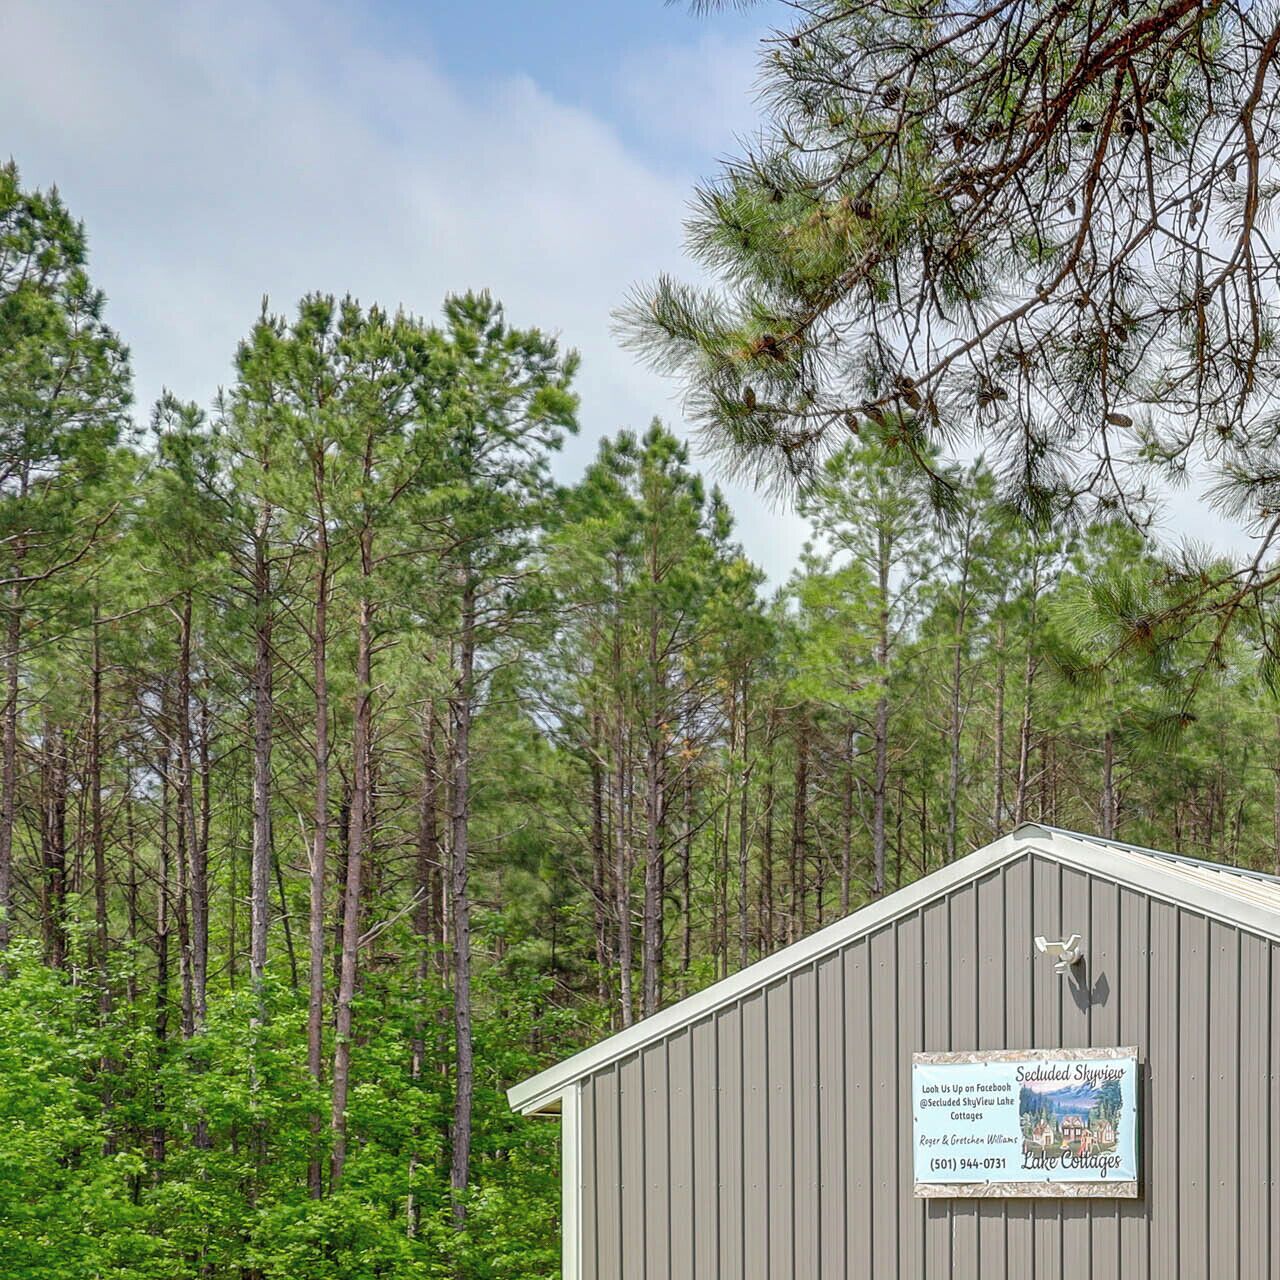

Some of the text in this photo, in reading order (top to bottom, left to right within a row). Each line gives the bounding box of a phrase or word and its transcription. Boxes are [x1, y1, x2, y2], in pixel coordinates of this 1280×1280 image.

[1016, 1064, 1126, 1088] Secluded Skyview
[922, 1084, 939, 1094] Look
[941, 1085, 950, 1093] Us
[953, 1084, 963, 1095] Up
[977, 1083, 1011, 1093] Facebook
[920, 1098, 961, 1108] @Secluded
[997, 1097, 1014, 1105] Lake
[951, 1111, 983, 1121] Cottages
[920, 1134, 1018, 1146] Roger & Gretchen Williams
[930, 1158, 1006, 1171] (501) 944-0731
[1021, 1150, 1122, 1178] Lake Cottages
